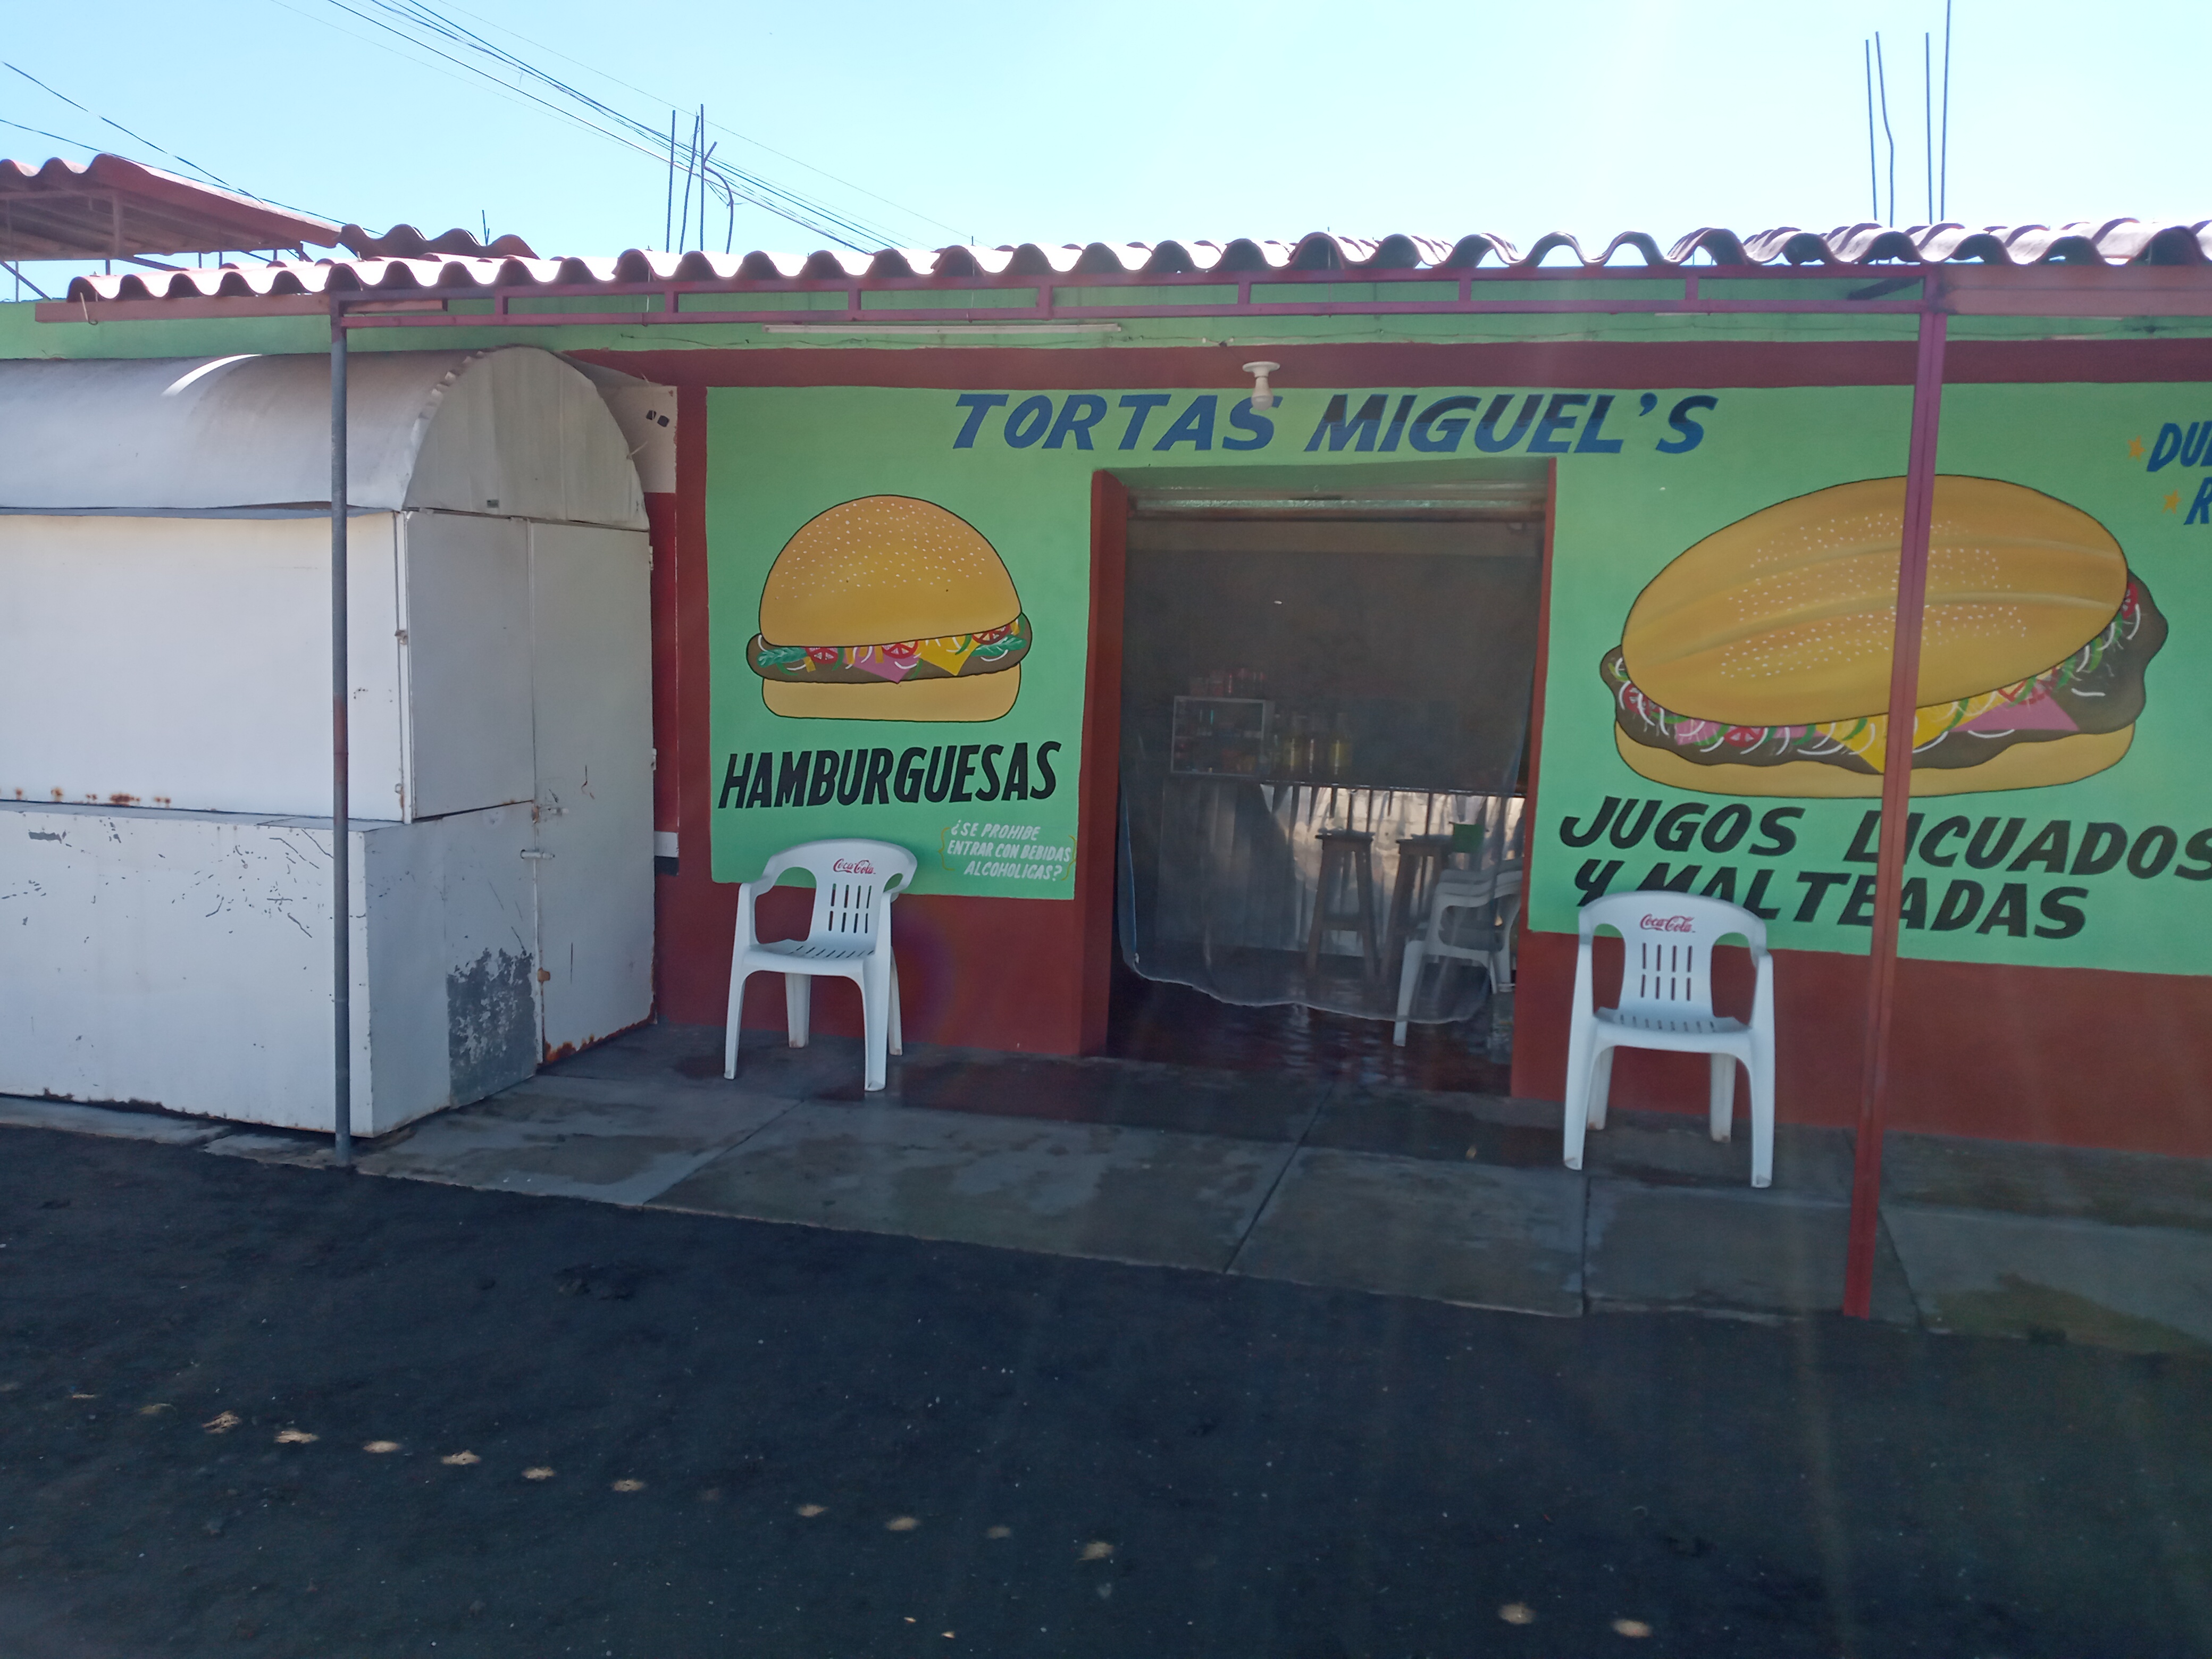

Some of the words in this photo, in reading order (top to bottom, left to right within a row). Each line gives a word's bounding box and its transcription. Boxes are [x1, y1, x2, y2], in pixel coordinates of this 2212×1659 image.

[953, 393, 1283, 451] TORTAS
[1303, 392, 1719, 454] MIGUEL'S
[718, 741, 1061, 809] HAMBURGUESAS
[981, 823, 1041, 841] PROHIBE
[1560, 795, 1806, 857] JUGOS
[947, 840, 993, 857] ENTRAR
[995, 843, 1020, 859] CON
[1020, 844, 1071, 862] BEBIDAS
[963, 860, 1062, 882] ALCOHOLICAS?
